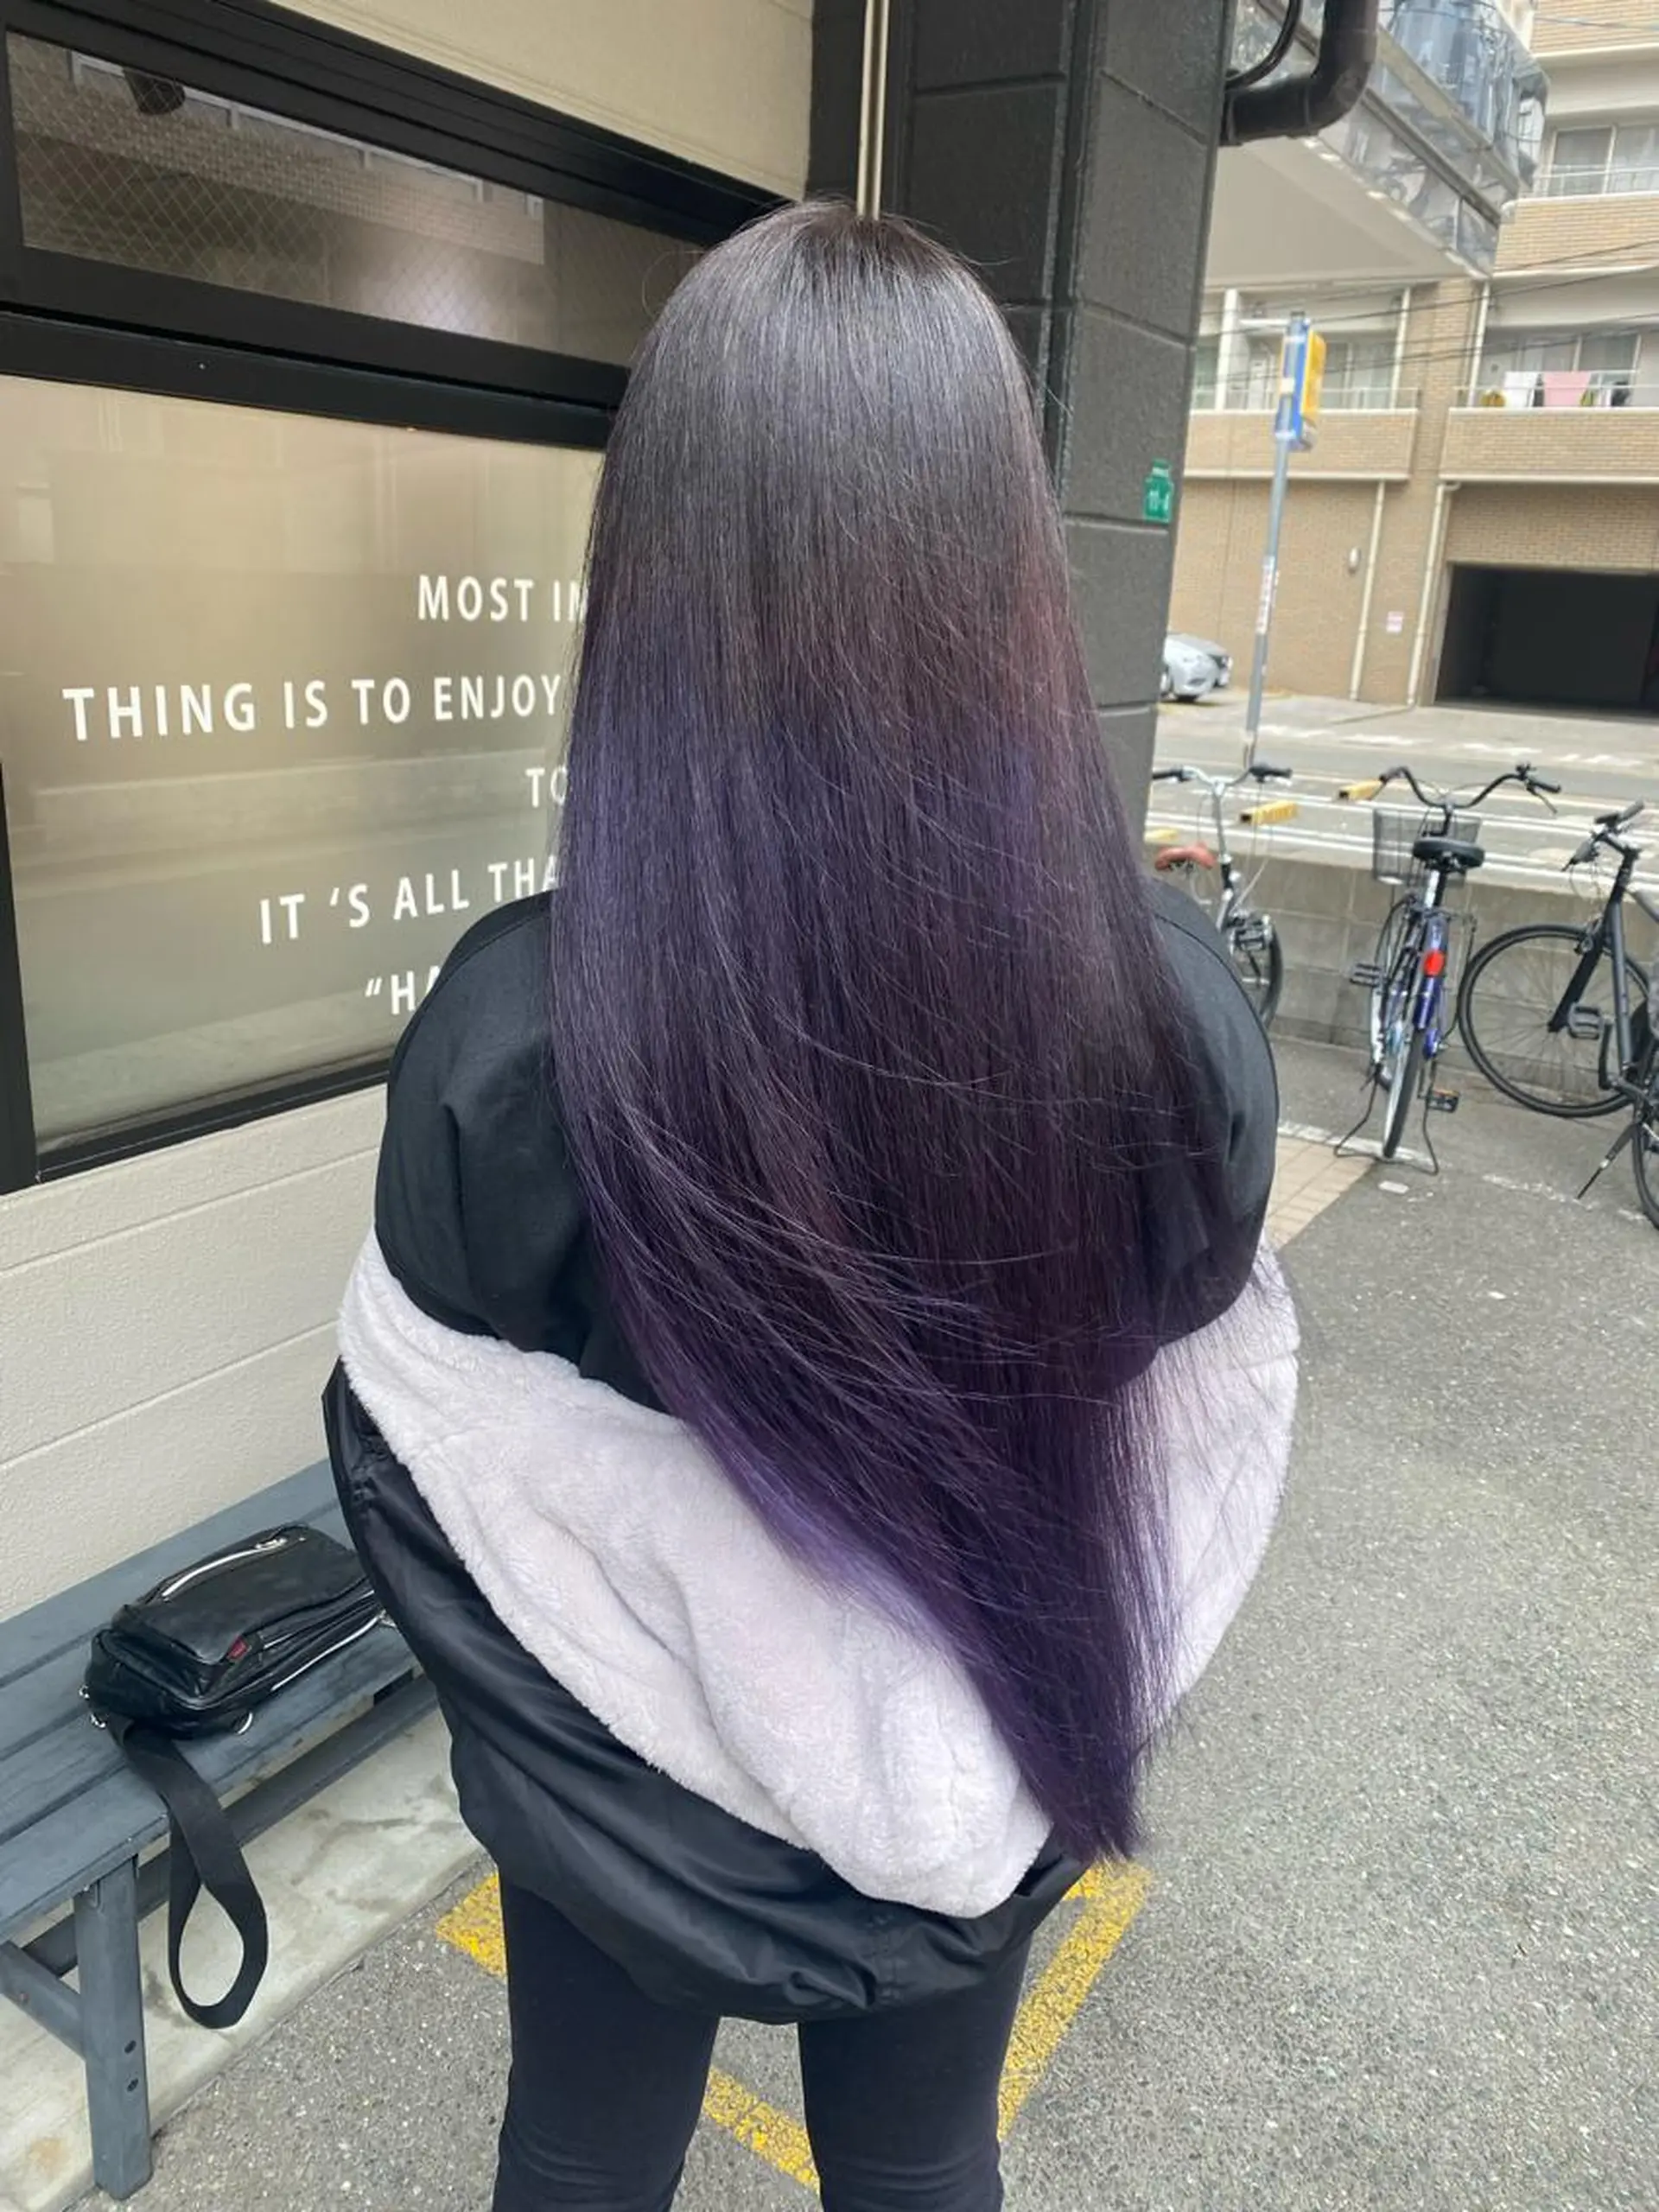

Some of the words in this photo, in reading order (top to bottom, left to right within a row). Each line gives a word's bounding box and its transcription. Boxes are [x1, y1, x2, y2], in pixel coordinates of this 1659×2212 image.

[419, 575, 534, 621] MOST
[62, 683, 255, 741] THING
[284, 680, 327, 728] IS
[352, 677, 410, 725] TO
[434, 674, 561, 721] ENJOY
[393, 869, 469, 920] ALL
